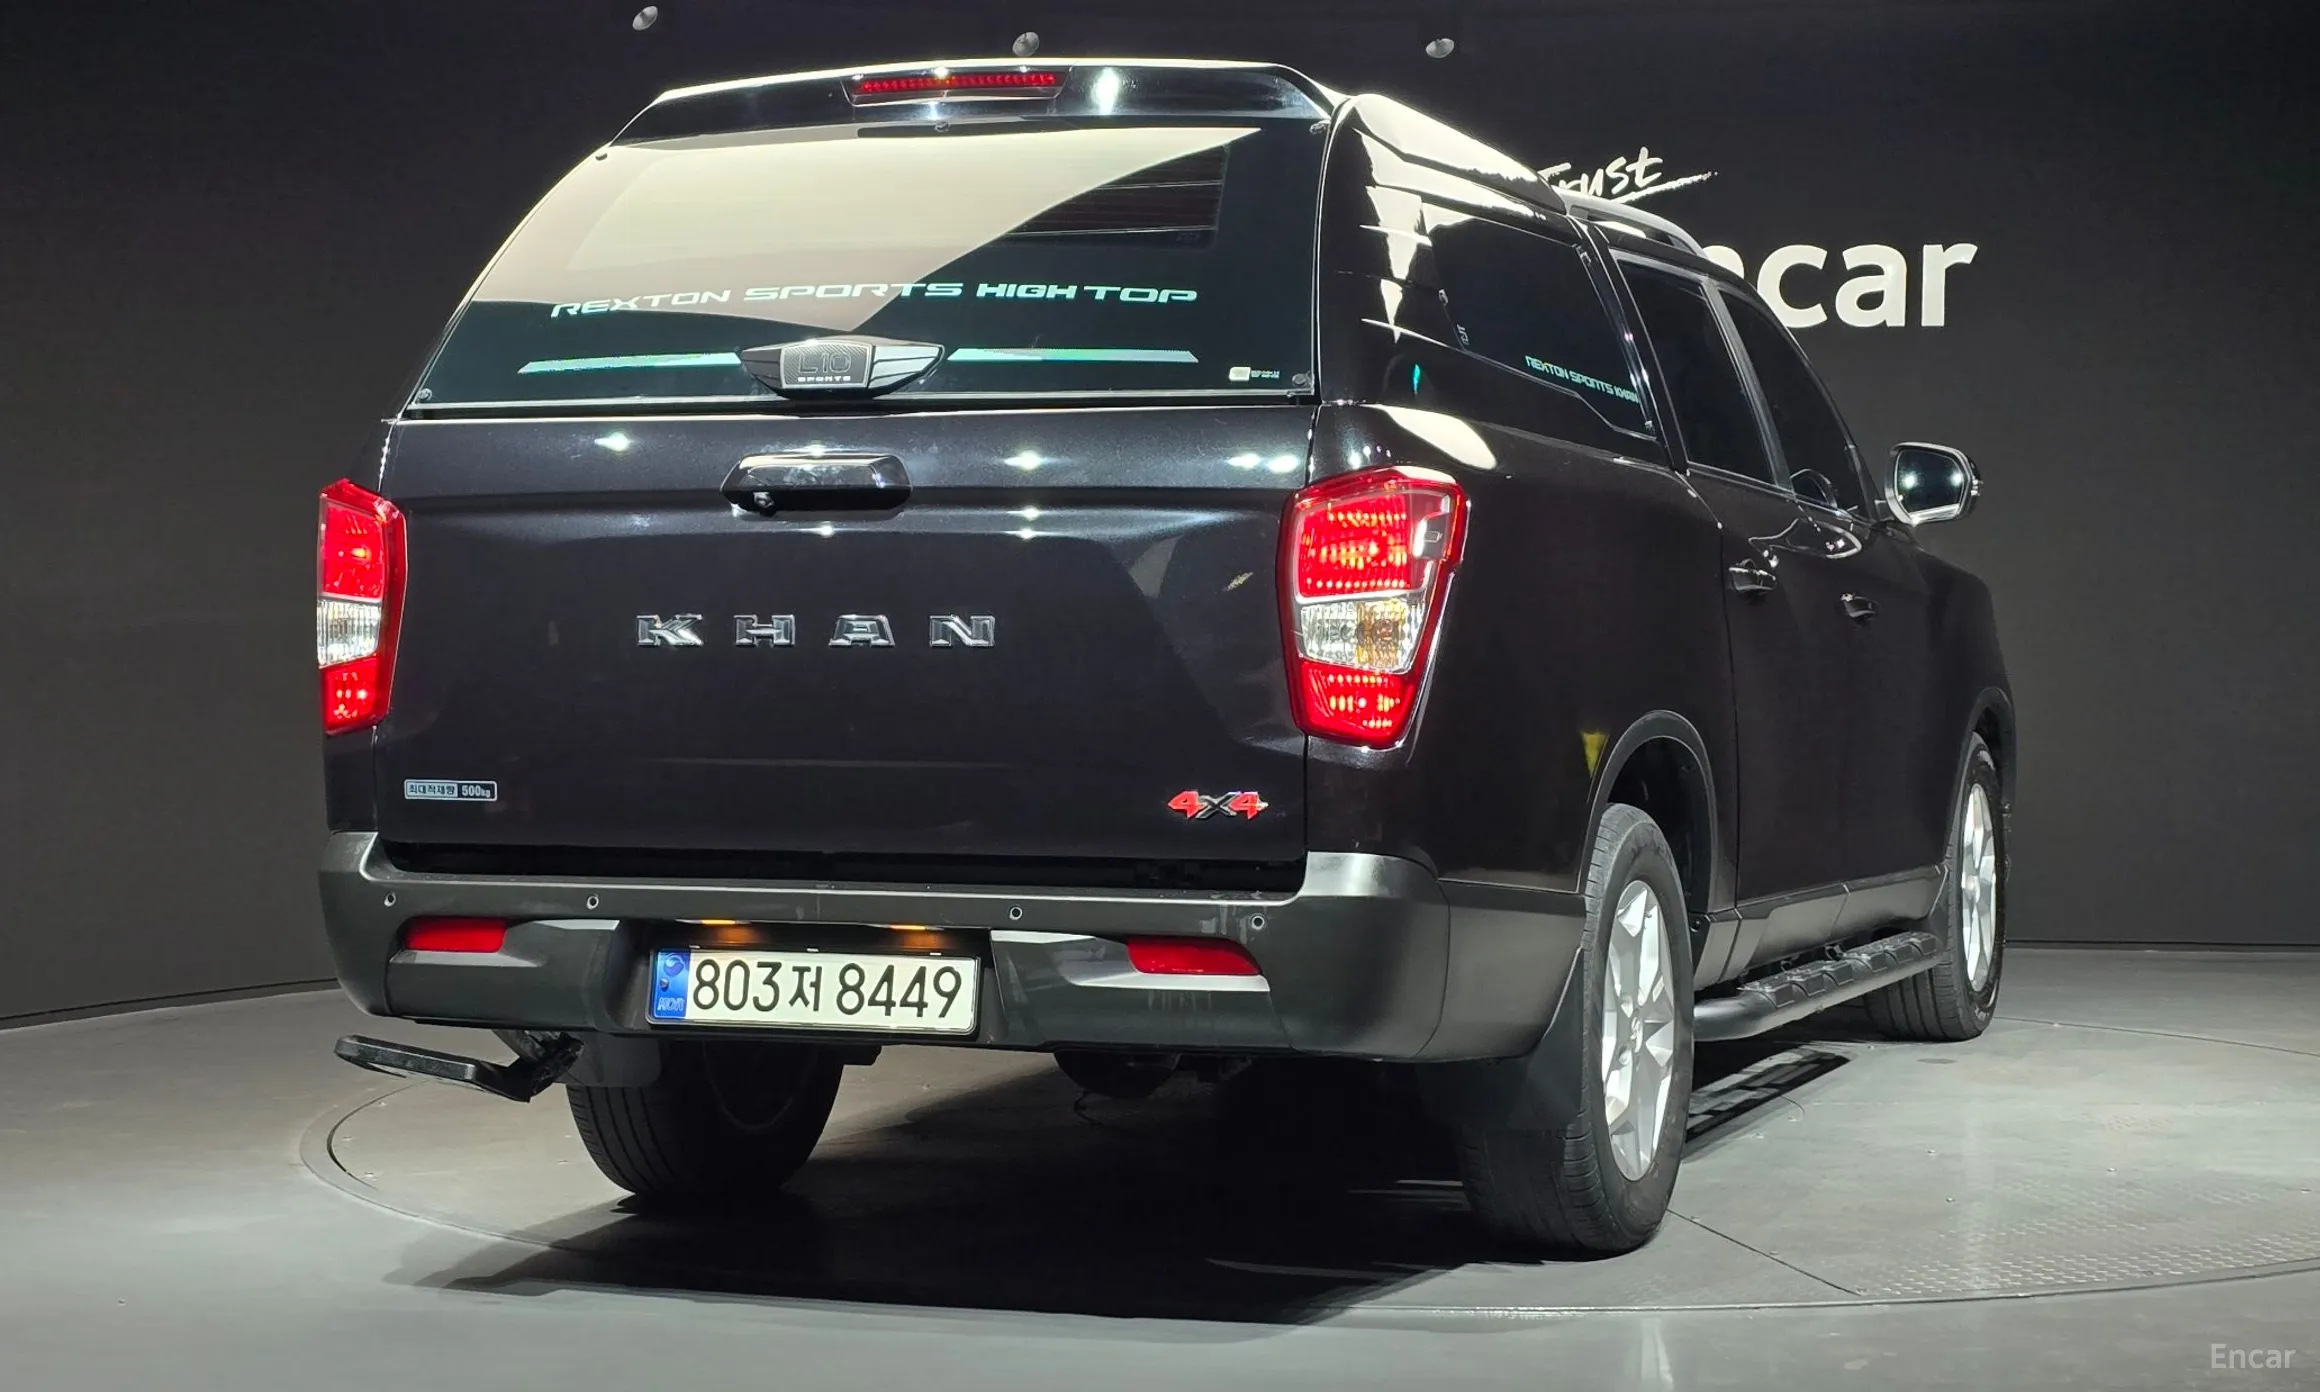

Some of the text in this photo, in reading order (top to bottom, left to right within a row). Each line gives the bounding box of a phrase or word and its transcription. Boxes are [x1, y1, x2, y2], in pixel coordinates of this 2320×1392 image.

[550, 282, 1198, 318] REXTON SPORTS HIGH TOP
[798, 352, 852, 374] L10
[636, 614, 996, 647] KHAN
[692, 958, 962, 1018] 803저 8449
